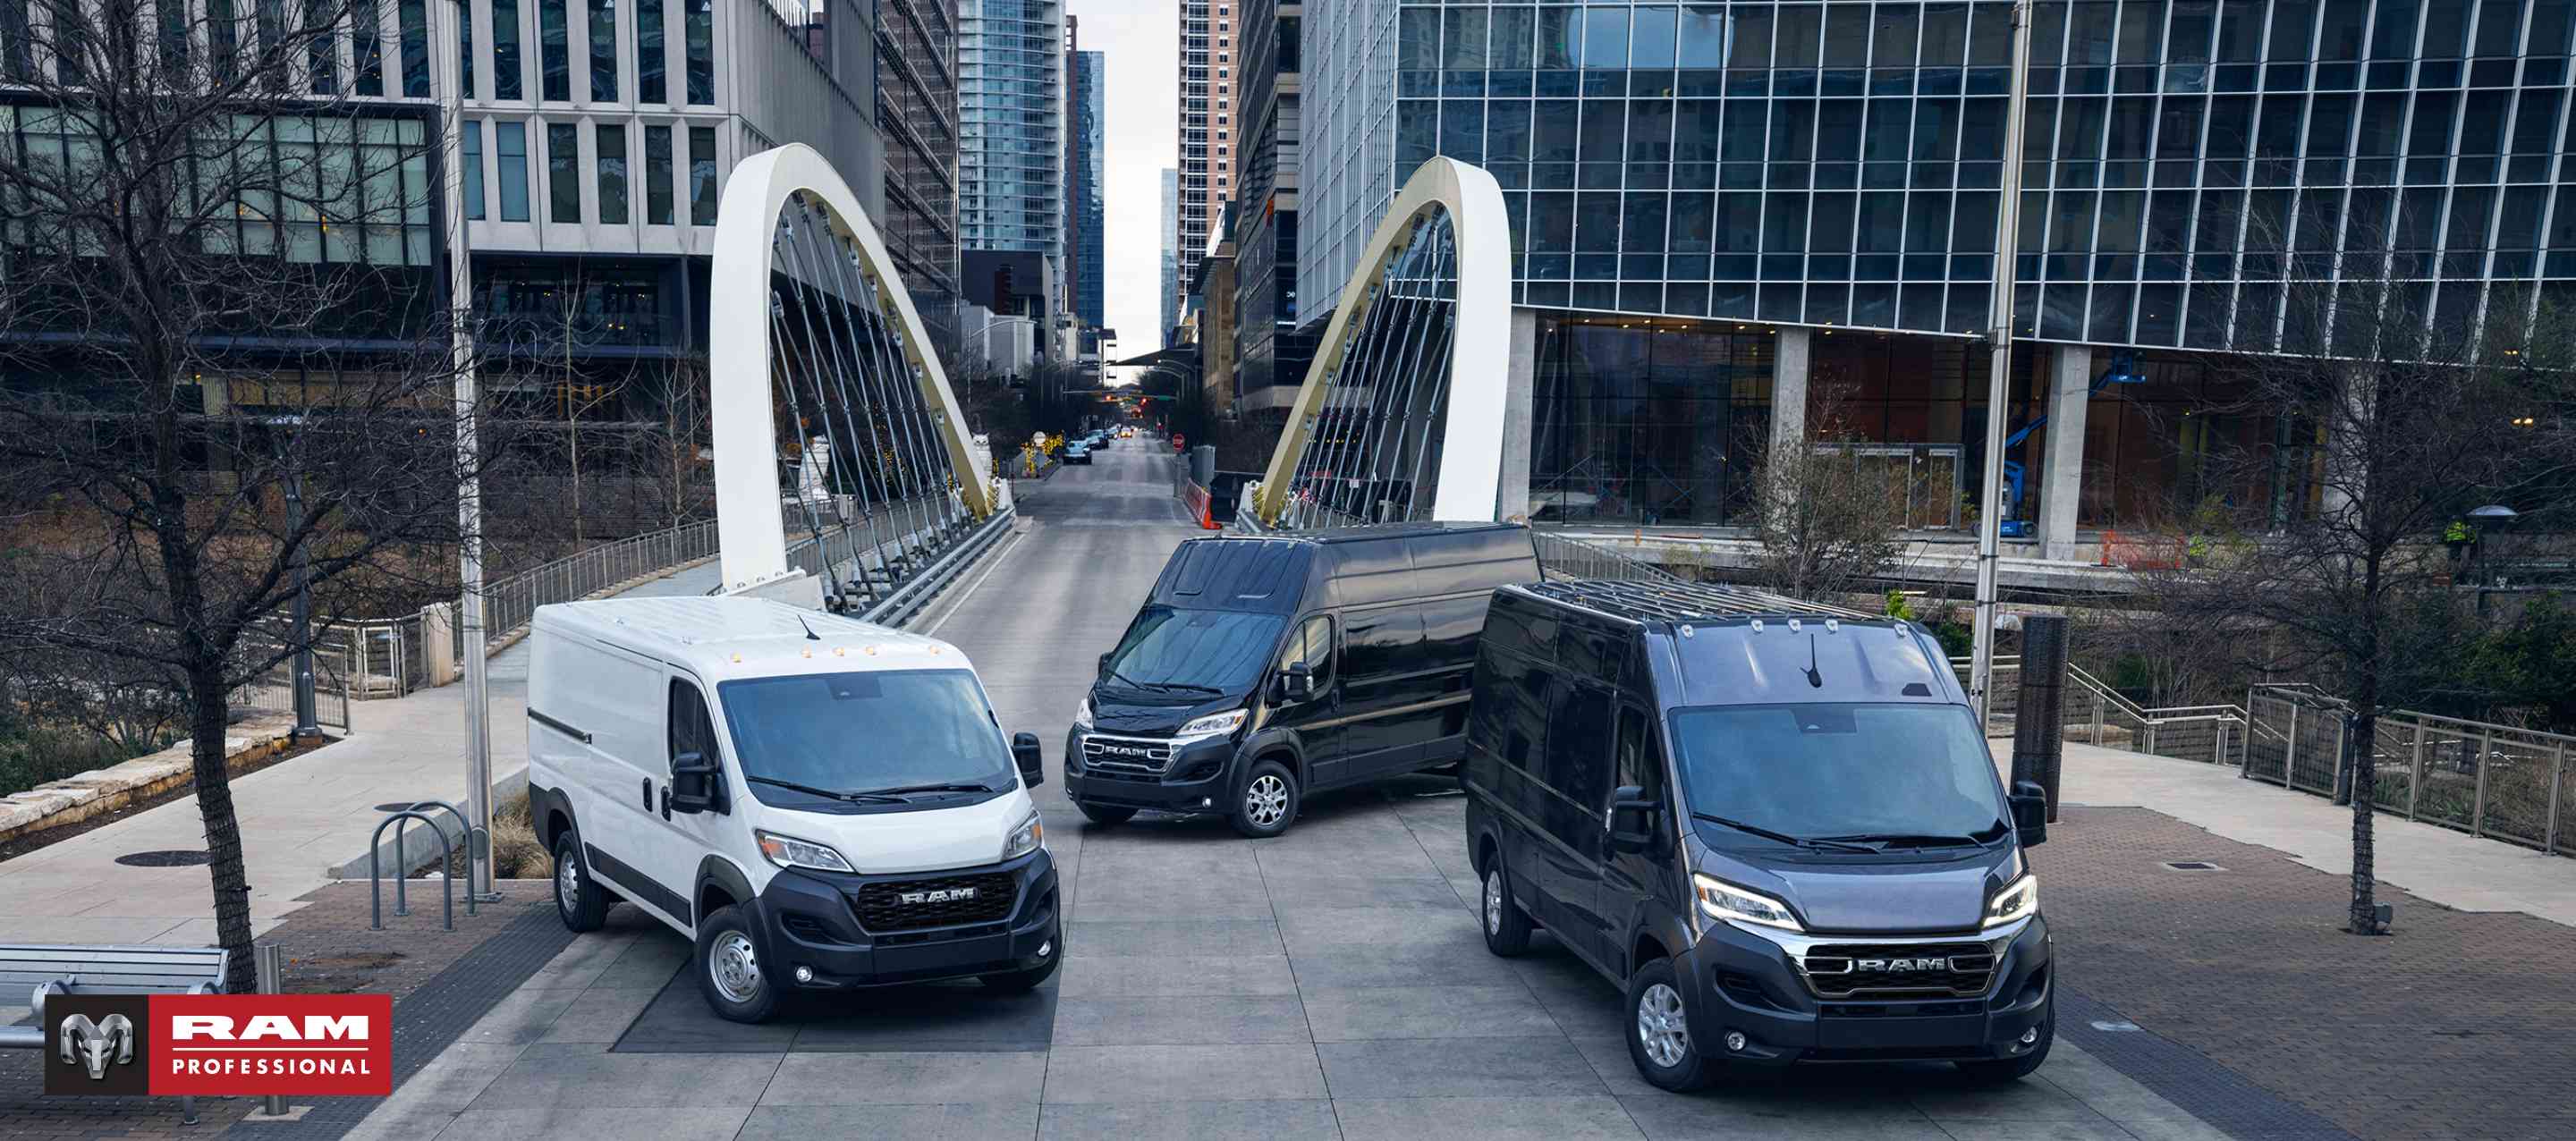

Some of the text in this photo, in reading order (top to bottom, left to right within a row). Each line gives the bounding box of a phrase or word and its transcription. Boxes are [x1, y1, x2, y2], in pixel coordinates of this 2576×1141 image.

[1106, 746, 1147, 756] RAM
[902, 888, 974, 904] RAM
[1859, 958, 1945, 971] RAM
